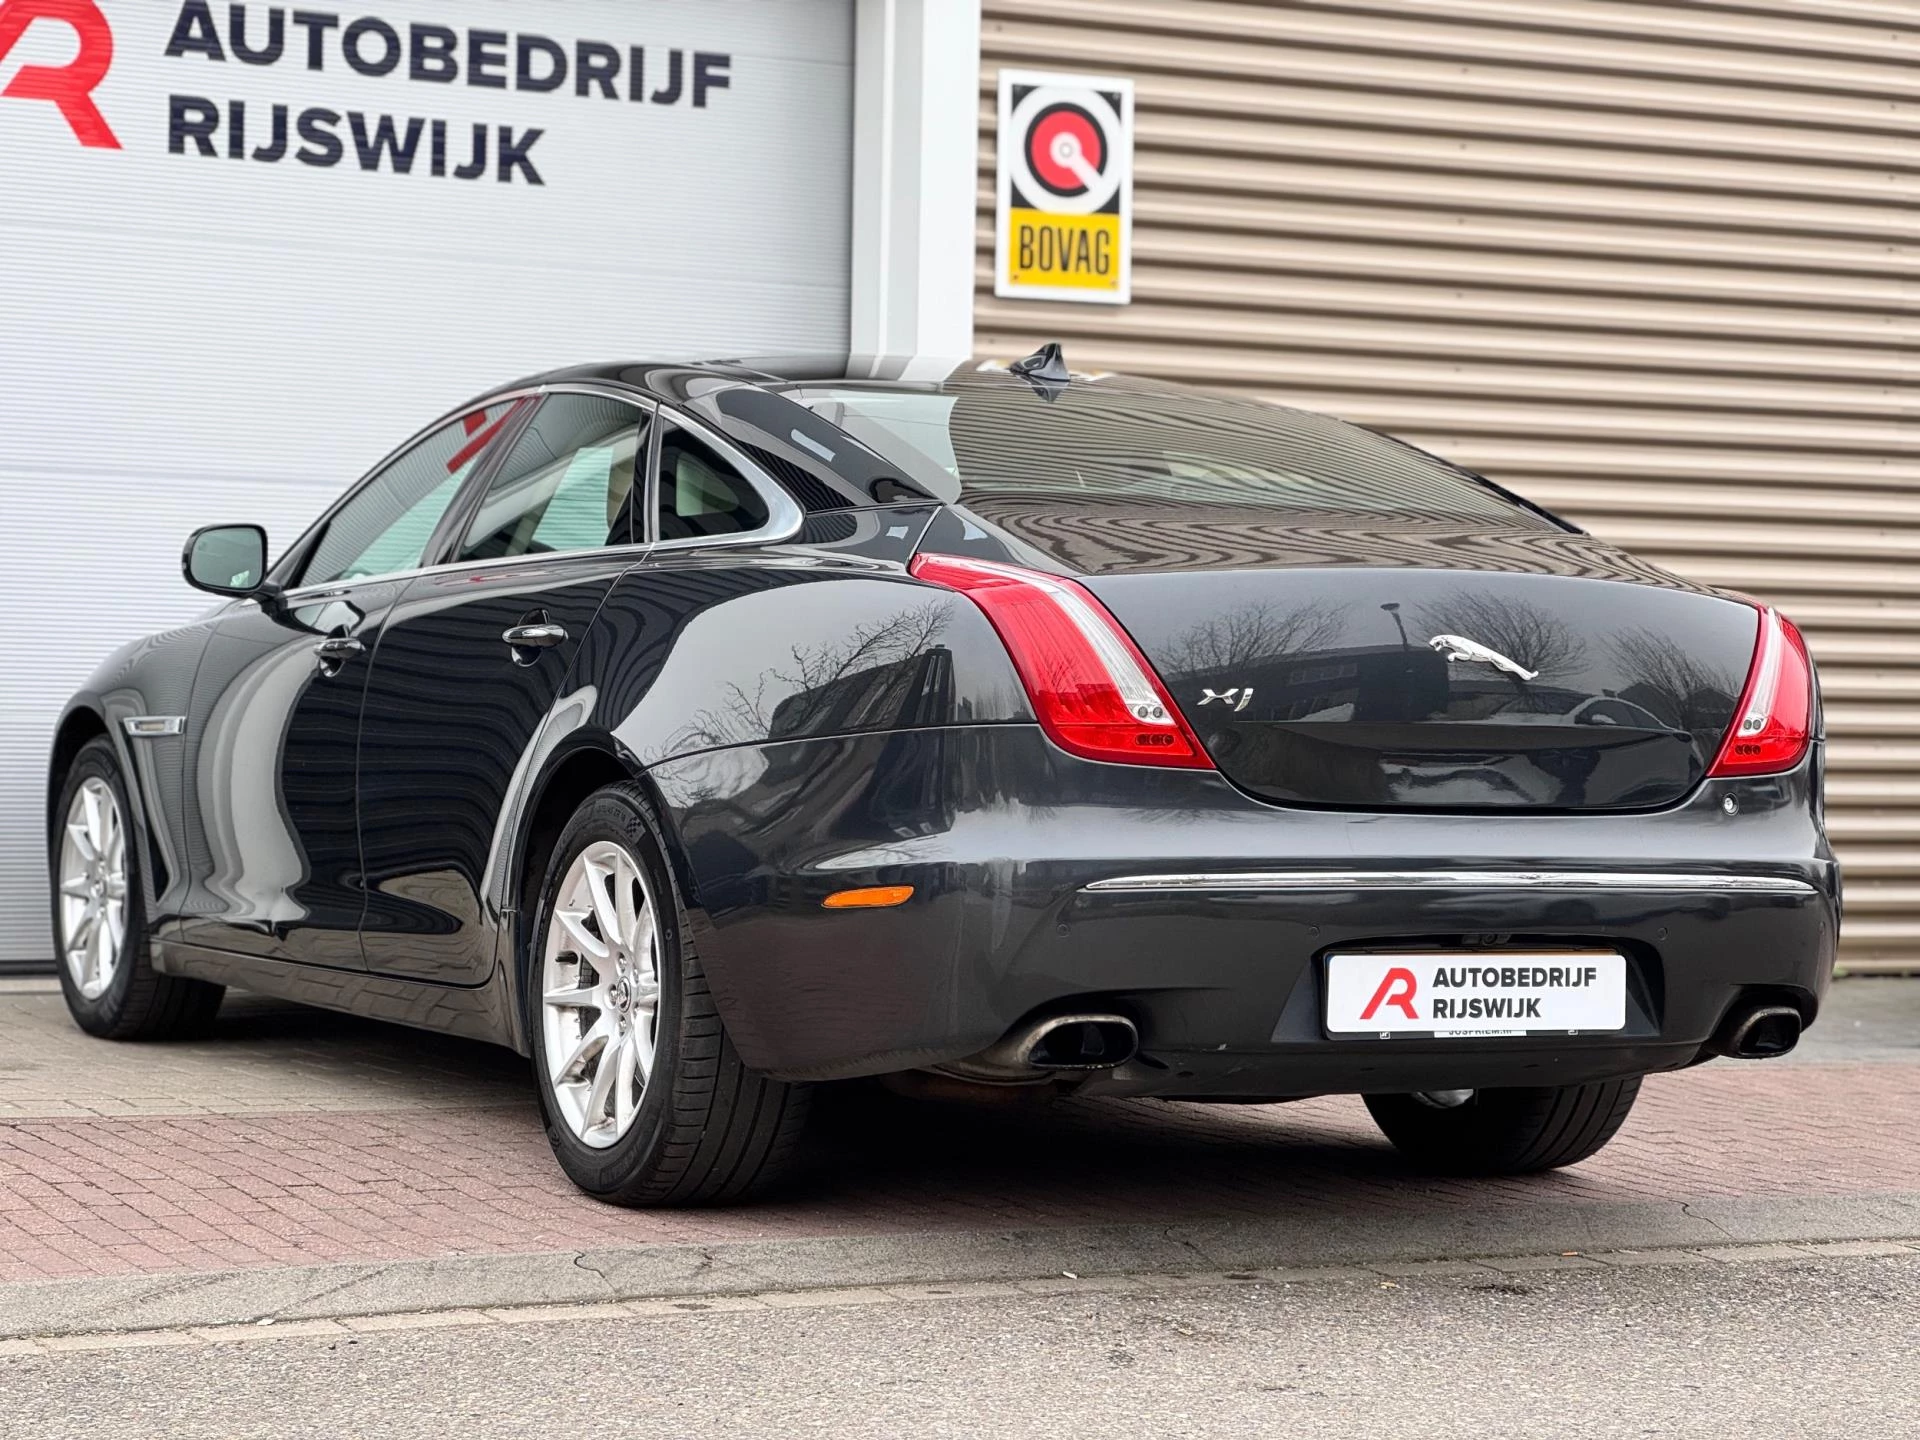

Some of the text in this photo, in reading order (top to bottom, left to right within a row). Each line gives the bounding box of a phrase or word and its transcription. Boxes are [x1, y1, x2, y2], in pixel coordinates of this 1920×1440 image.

[164, 0, 731, 108] AUTOBEDRIJF
[168, 94, 545, 186] RIJSWIJK
[1019, 224, 1110, 275] BOVAG
[1432, 967, 1597, 988] AUTOBEDRIJF
[1432, 997, 1541, 1018] RIJSWIJK
